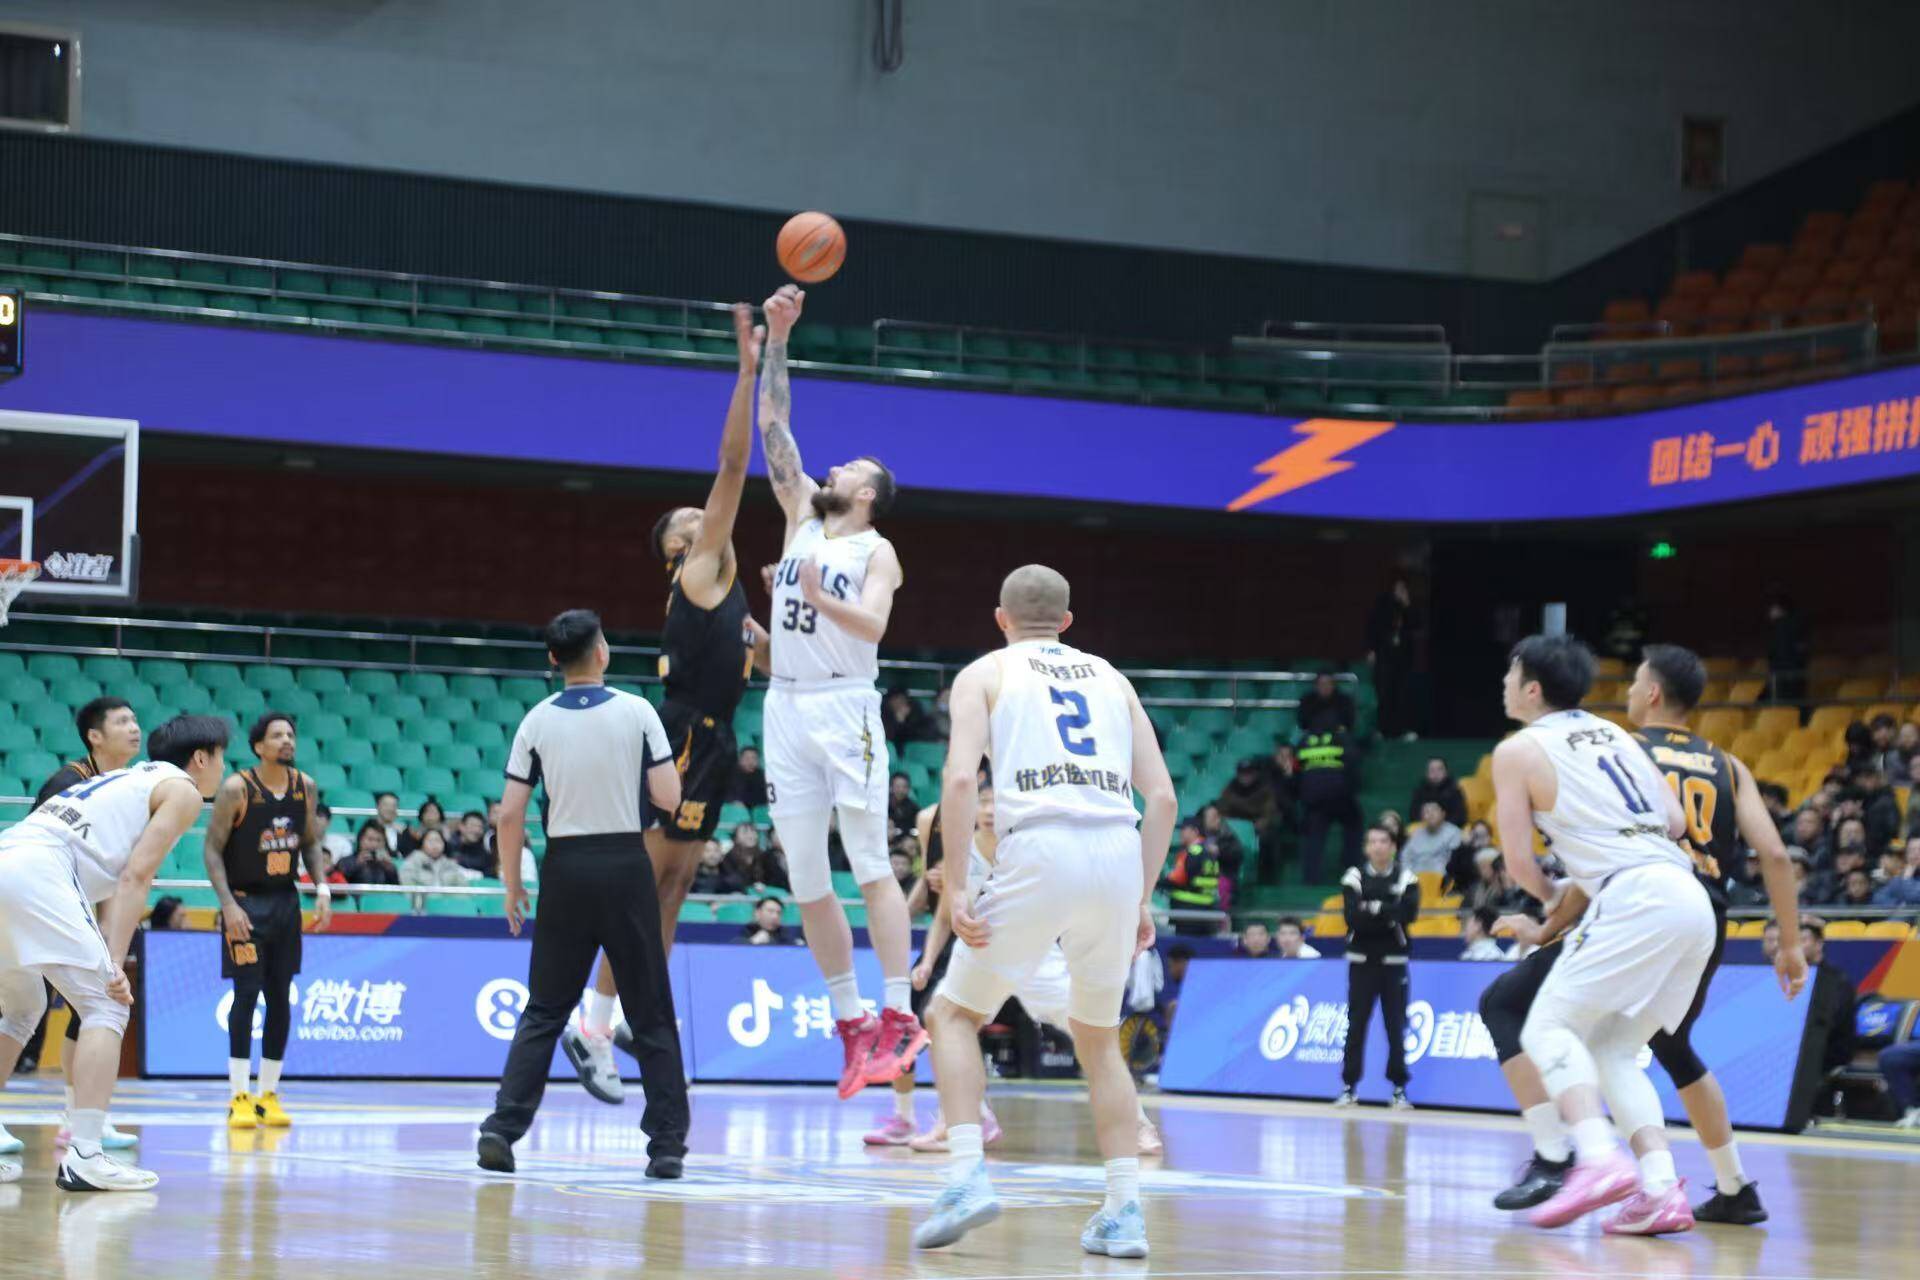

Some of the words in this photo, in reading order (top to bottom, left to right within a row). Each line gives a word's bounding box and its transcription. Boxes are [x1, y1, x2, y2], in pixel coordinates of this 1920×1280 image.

[1649, 420, 1780, 487] 团结一心
[782, 598, 819, 635] 33
[1048, 685, 1097, 757] 2
[1597, 754, 1653, 814] 11
[302, 978, 407, 1025] 微博
[297, 1024, 404, 1042] weibo.com
